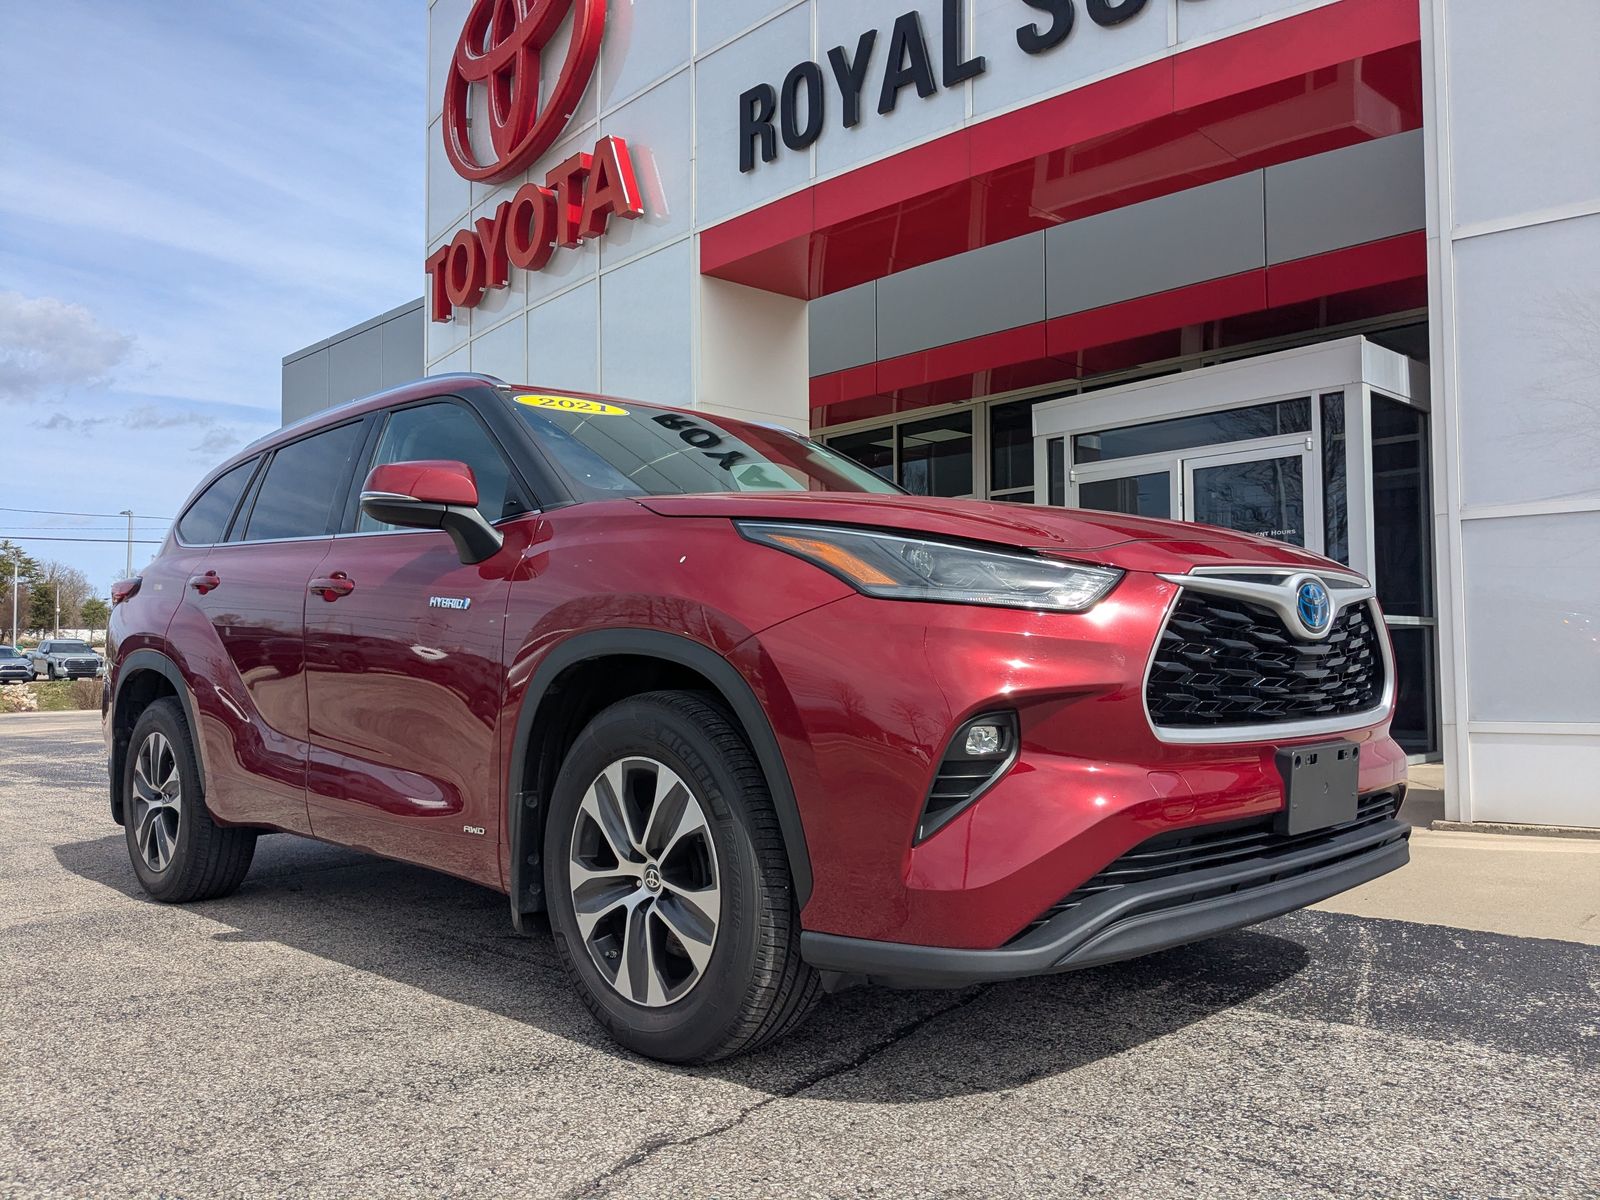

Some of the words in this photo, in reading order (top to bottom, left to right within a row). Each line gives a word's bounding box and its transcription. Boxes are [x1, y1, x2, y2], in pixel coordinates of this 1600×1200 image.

[739, 0, 986, 173] ROYAL
[425, 134, 644, 323] TOYOTA
[538, 398, 607, 412] 2021
[429, 596, 464, 609] HYBRID
[656, 725, 731, 820] MICHELIN
[463, 825, 485, 835] AWD
